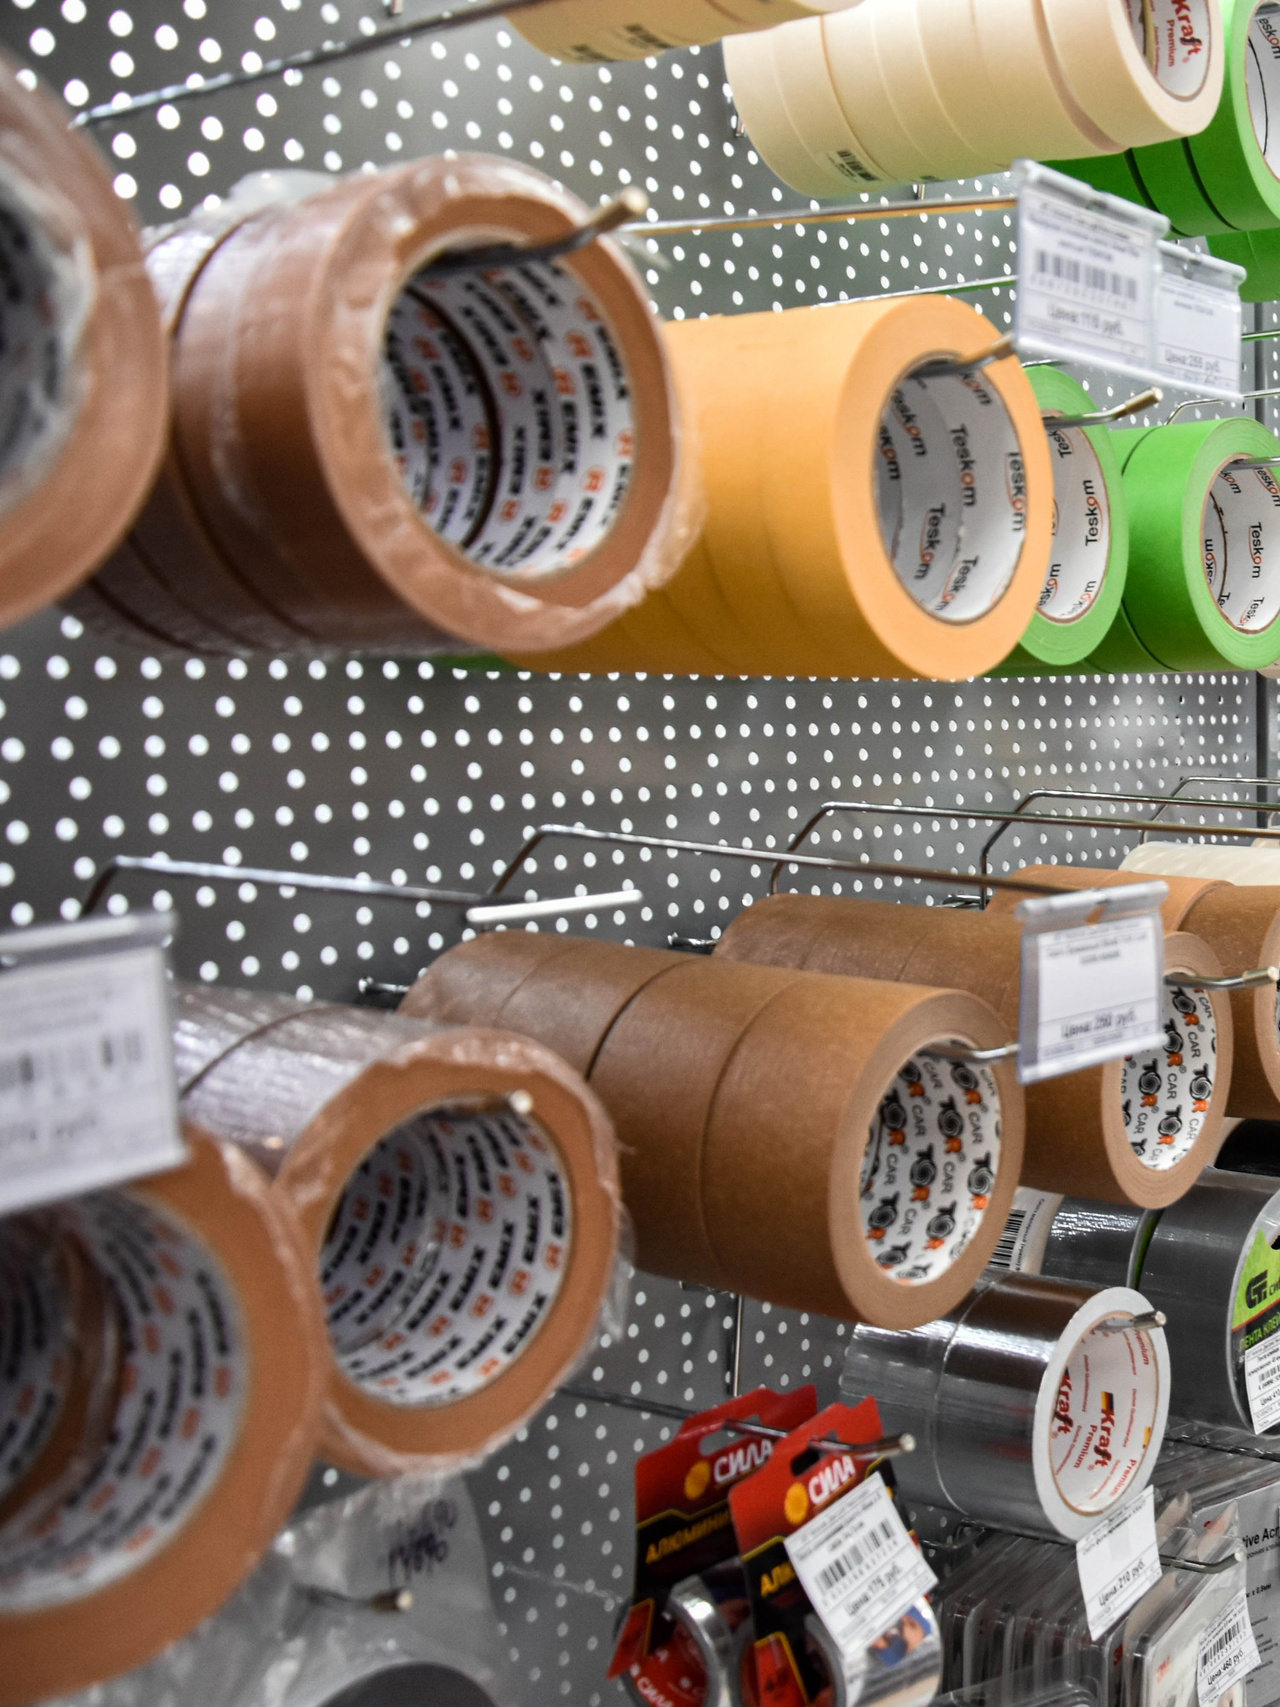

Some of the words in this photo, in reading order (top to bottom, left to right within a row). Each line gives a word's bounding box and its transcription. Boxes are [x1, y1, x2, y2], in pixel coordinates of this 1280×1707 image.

[1167, 19, 1175, 67] Premium
[950, 424, 976, 507] Teskom
[1082, 479, 1099, 546] Teskom
[1250, 522, 1264, 579] Teskom
[1240, 1327, 1263, 1350] ЛЕНТА
[1054, 1374, 1074, 1434] Kraft
[713, 1438, 773, 1483] СИЛА
[1074, 1424, 1098, 1468] Premium
[1094, 1408, 1115, 1467] Kraft
[808, 1455, 856, 1504] СИЛА
